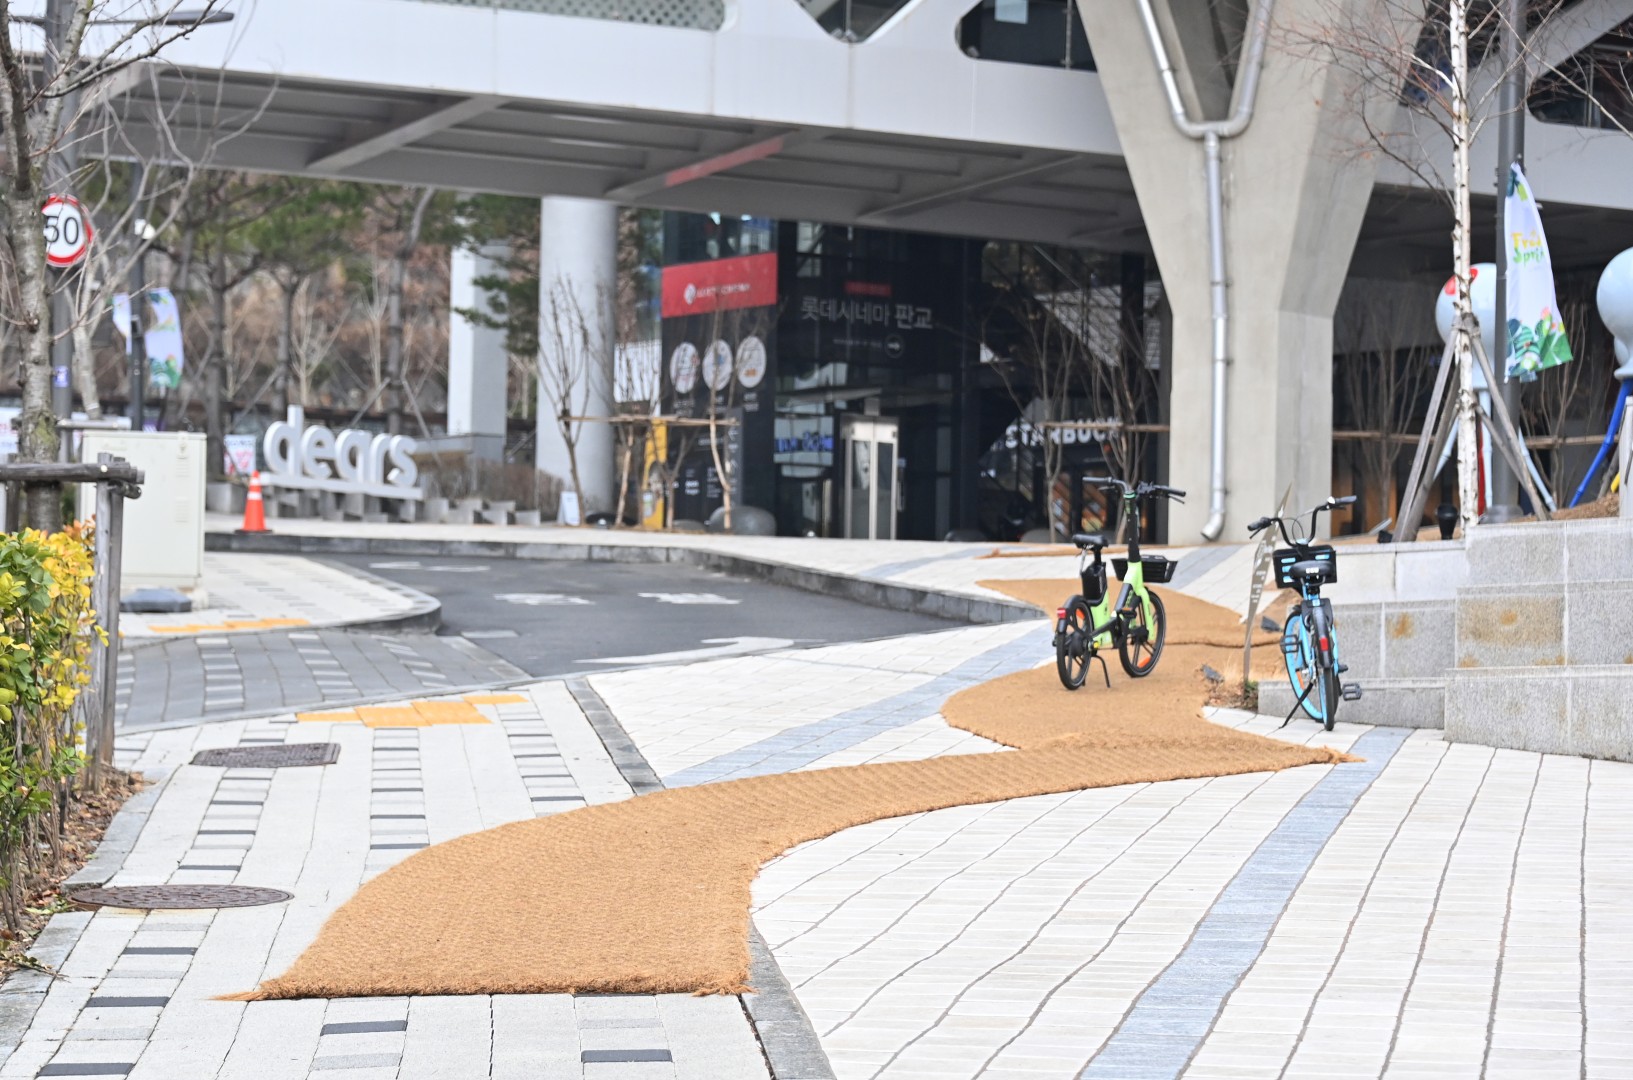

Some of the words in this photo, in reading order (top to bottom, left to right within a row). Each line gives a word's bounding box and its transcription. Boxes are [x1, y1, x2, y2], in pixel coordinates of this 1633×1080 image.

[45, 216, 79, 245] 50
[801, 296, 890, 327] 롯데시네마
[895, 303, 934, 330] 판교
[263, 404, 418, 487] dears
